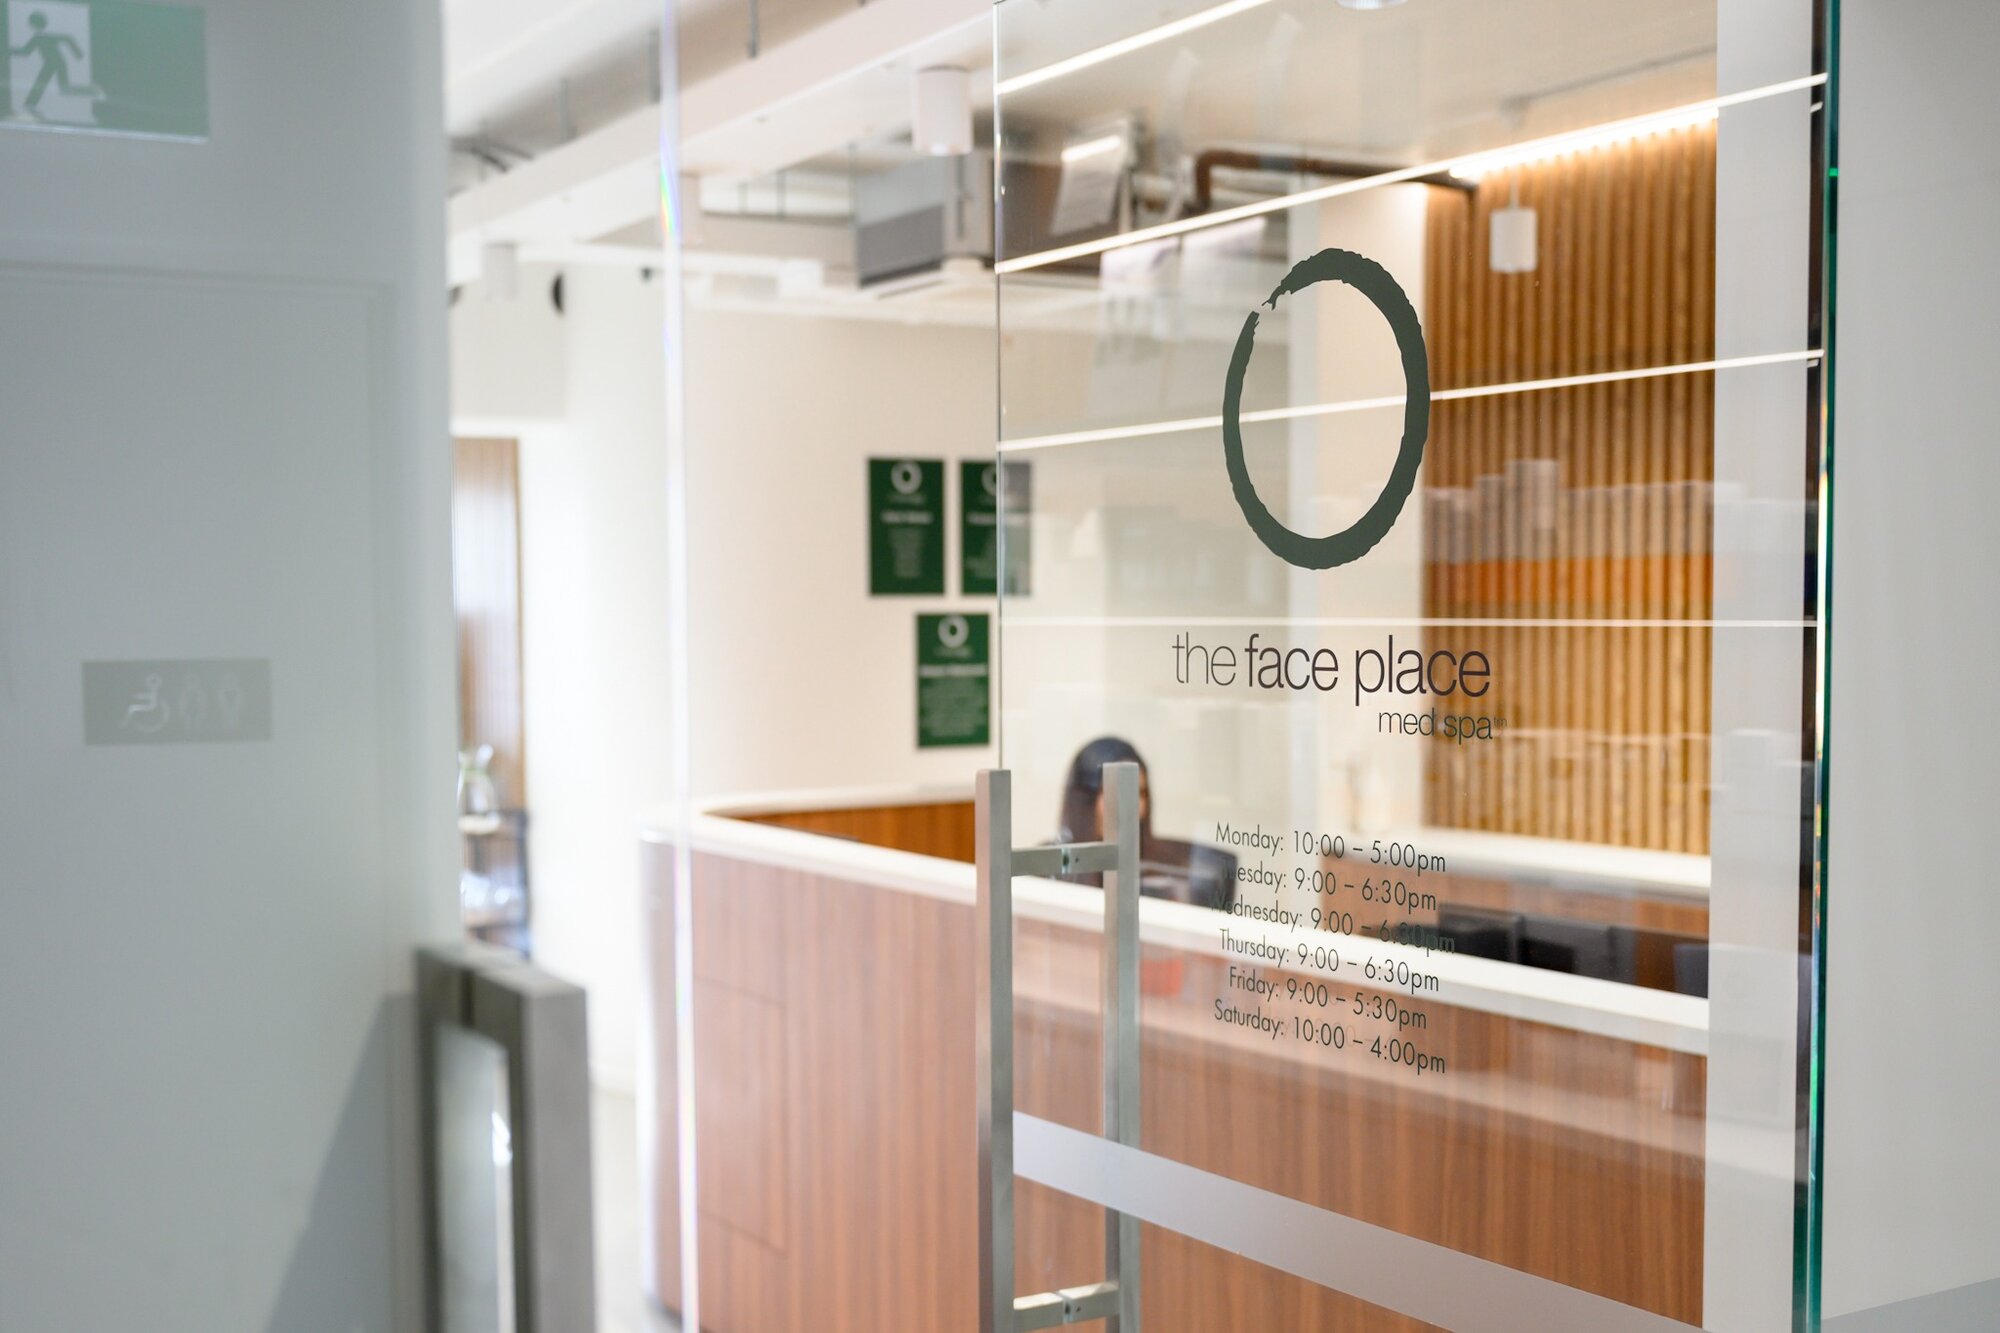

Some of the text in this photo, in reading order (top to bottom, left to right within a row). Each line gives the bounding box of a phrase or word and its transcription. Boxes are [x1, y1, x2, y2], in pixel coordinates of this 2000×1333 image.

[1172, 632, 1490, 706] the face place
[1379, 707, 1436, 736] med
[1216, 822, 1284, 856] Monday:
[1294, 830, 1345, 859] 10:00
[1370, 840, 1446, 877] 5:00pm
[1294, 867, 1336, 895] 9:00
[1361, 878, 1436, 914] 6:30pm
[1311, 907, 1353, 936] 9:00
[1219, 928, 1289, 968] Thursday:
[1297, 943, 1339, 972] 9:00
[1364, 956, 1439, 994] 6:30pm
[1229, 966, 1279, 1002] Friday:
[1287, 978, 1328, 1007] 9:00
[1353, 992, 1427, 1031] 5:30pm
[1214, 999, 1284, 1040] Saturday:
[1294, 1016, 1345, 1049] 10:00
[1370, 1035, 1445, 1075] 4:00pm
